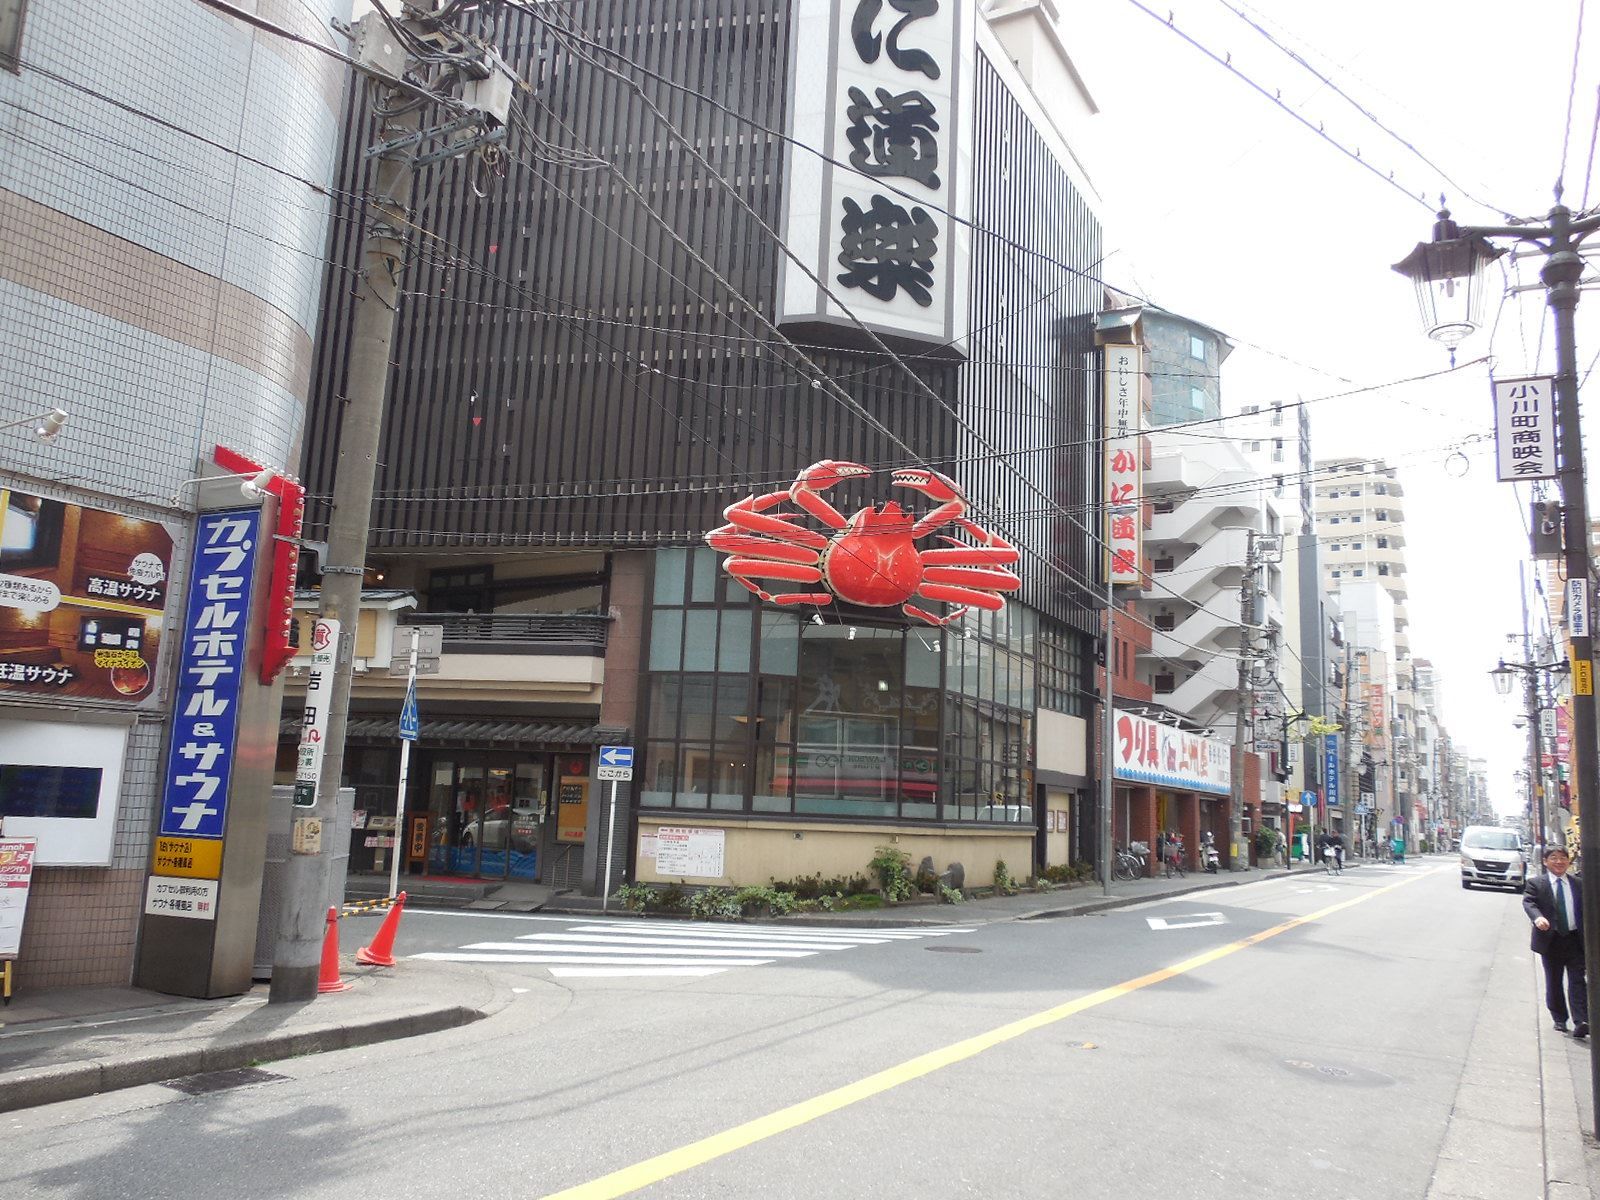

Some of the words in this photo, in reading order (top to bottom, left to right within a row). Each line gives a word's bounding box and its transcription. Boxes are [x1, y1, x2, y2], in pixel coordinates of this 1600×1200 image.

[1509, 385, 1543, 475] 小川町商映会
[1110, 450, 1136, 574] かに道楽
[88, 577, 160, 601] 高温サウナ
[1117, 716, 1159, 770] つり具
[600, 769, 630, 779] ここから
